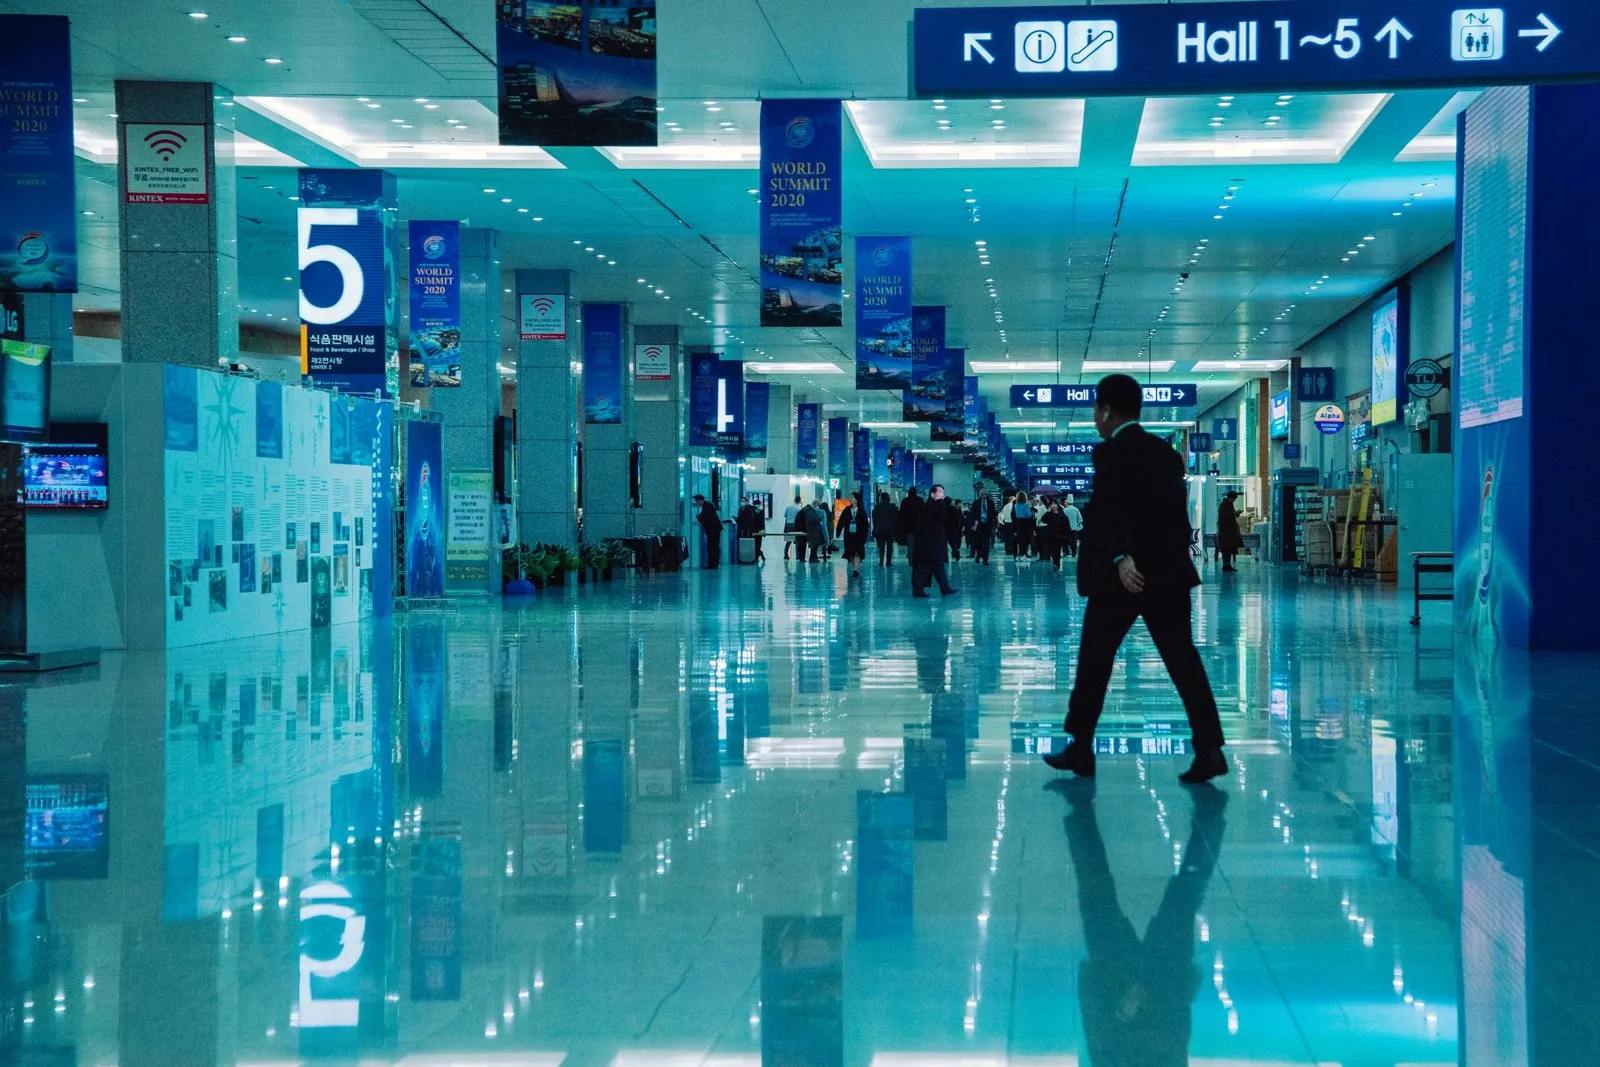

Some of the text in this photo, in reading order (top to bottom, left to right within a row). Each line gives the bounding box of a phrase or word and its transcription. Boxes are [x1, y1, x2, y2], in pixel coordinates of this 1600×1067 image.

[1177, 17, 1361, 63] Hall 1~5
[12, 120, 48, 132] 2020
[771, 162, 827, 175] WORLD
[770, 178, 831, 191] SUMMIT
[129, 195, 164, 203] KINTEX
[771, 193, 805, 207] 2020
[297, 208, 364, 325] 5
[416, 268, 453, 276] WORLD
[414, 277, 455, 285] SUMMIT
[863, 276, 901, 284] WORLD
[424, 286, 446, 294] 2020
[862, 286, 904, 295] SUMMIT
[863, 296, 887, 306] 2020
[7, 310, 18, 332] LG
[309, 334, 375, 346] 식음판매시설
[1066, 388, 1089, 401] Hall
[1057, 444, 1086, 453] Hall 1~3
